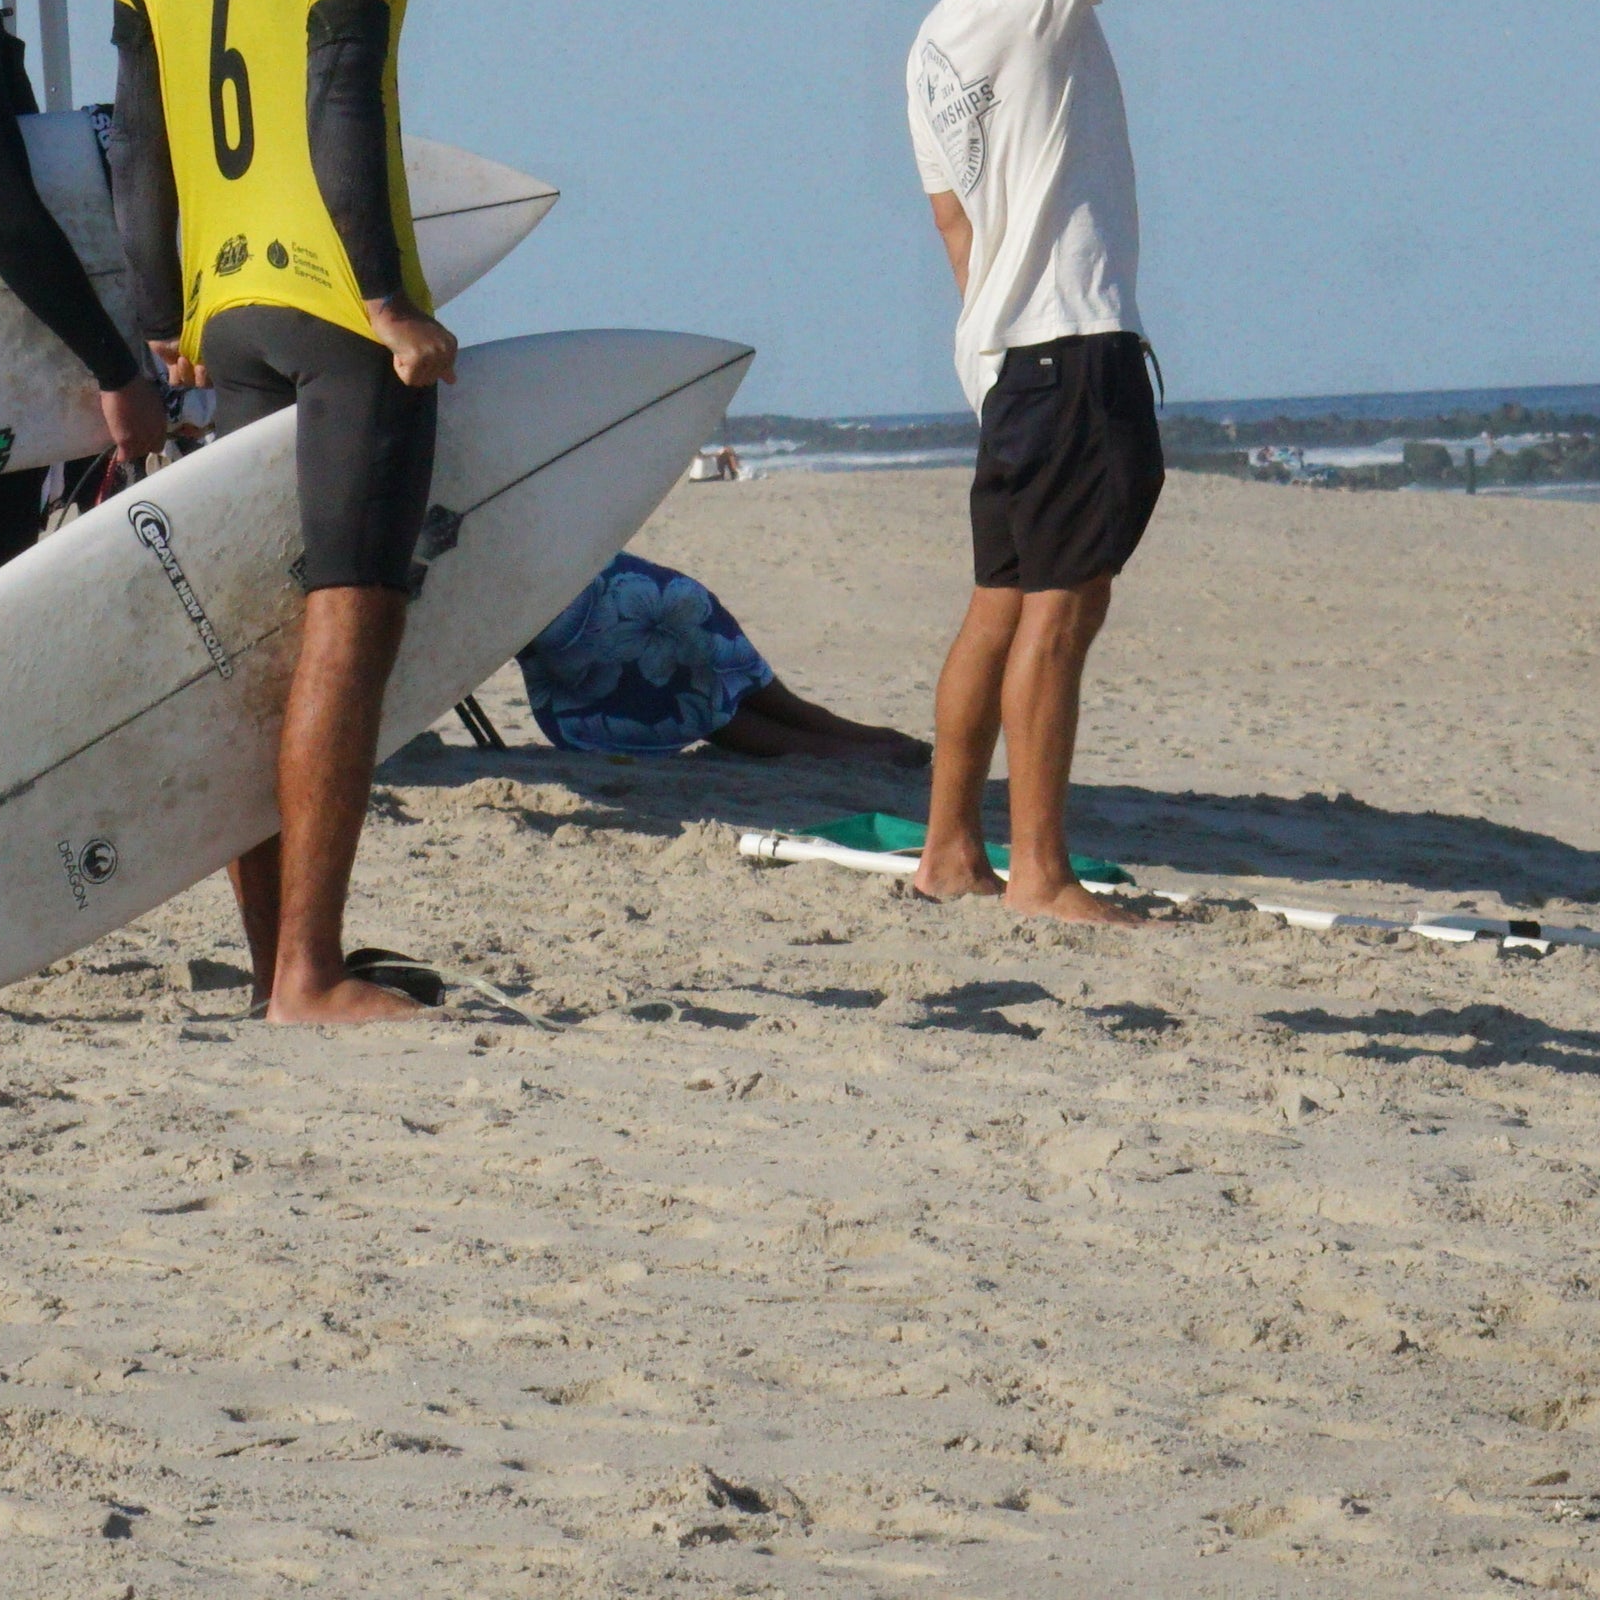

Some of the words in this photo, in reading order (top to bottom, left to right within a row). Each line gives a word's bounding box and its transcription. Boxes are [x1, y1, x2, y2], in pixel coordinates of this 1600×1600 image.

[141, 522, 184, 582] BRAVE
[174, 579, 204, 619] NEW
[199, 617, 234, 680] WORLD
[58, 840, 89, 911] DRAGON
